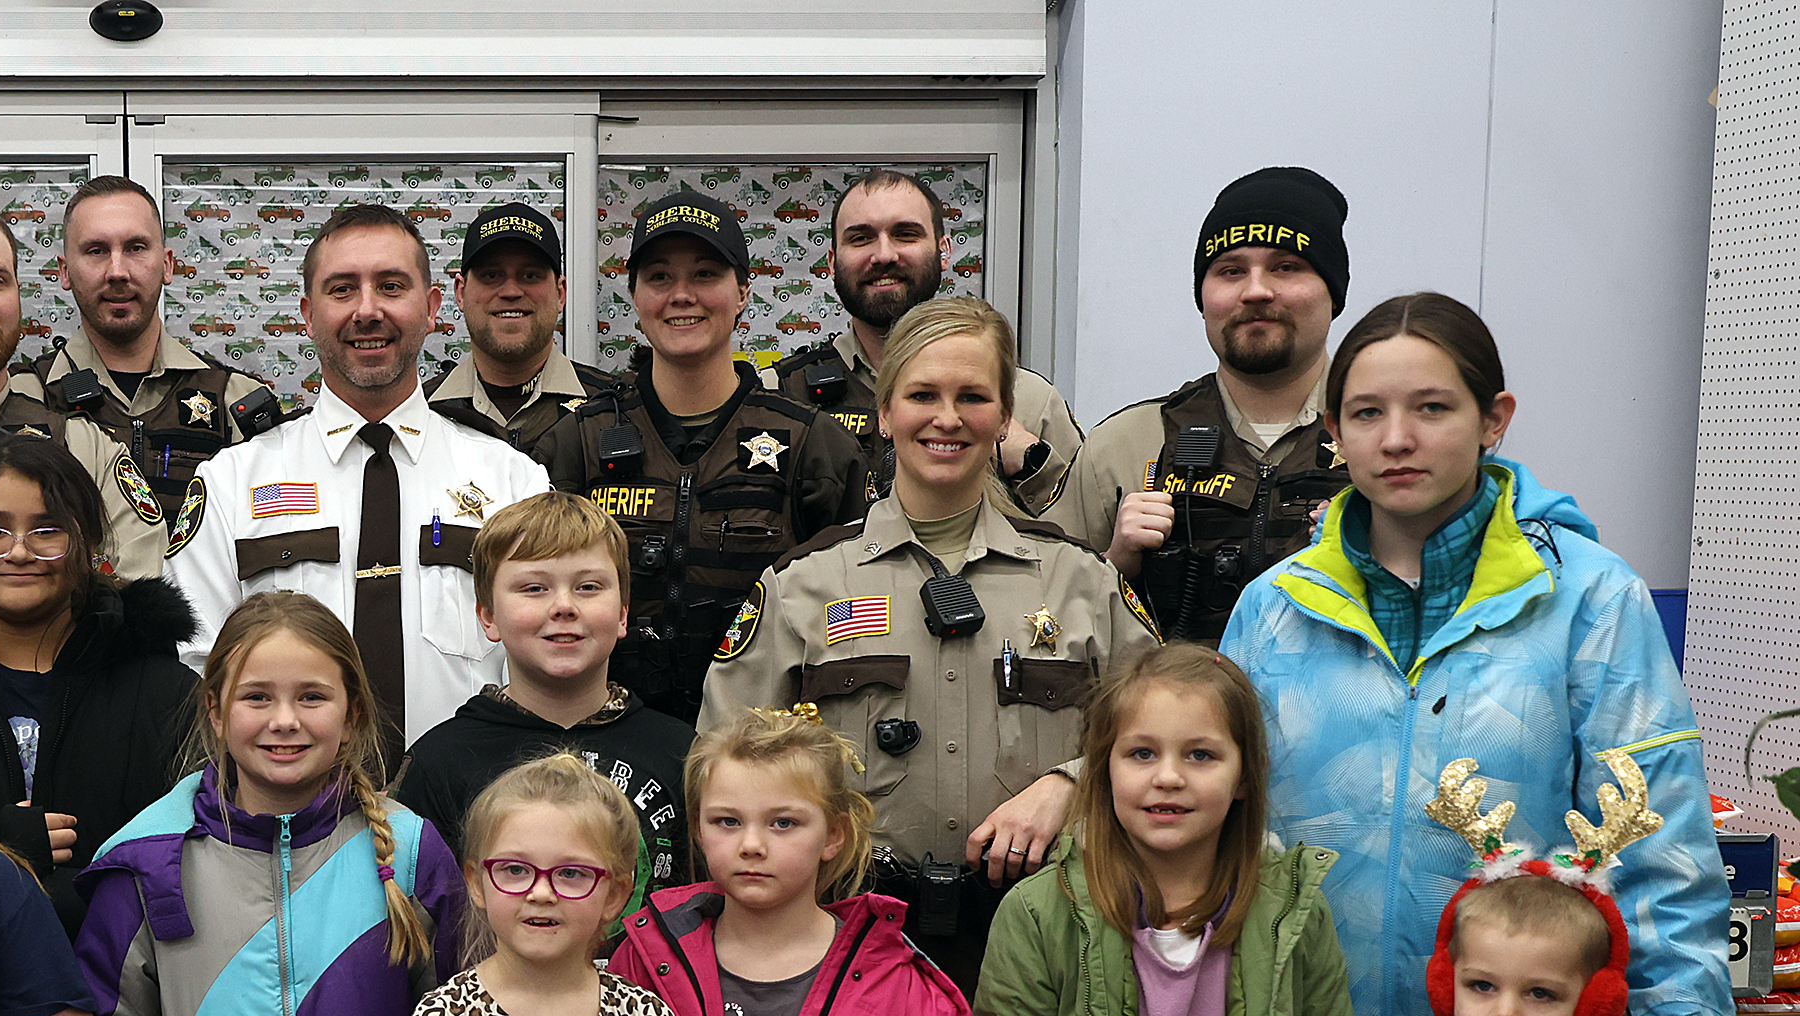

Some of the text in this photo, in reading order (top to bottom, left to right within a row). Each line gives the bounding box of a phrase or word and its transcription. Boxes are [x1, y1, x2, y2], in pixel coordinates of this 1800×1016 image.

[480, 216, 544, 235] SHERIFF
[645, 215, 720, 237] NOBLES COUNTY
[646, 205, 721, 229] SHERIFF
[480, 225, 543, 241] NOBLES COUNTY
[1205, 224, 1310, 258] SHERIFF
[829, 413, 868, 434] RIFF
[590, 487, 656, 517] SHERIFF
[1728, 920, 1749, 962] 8
